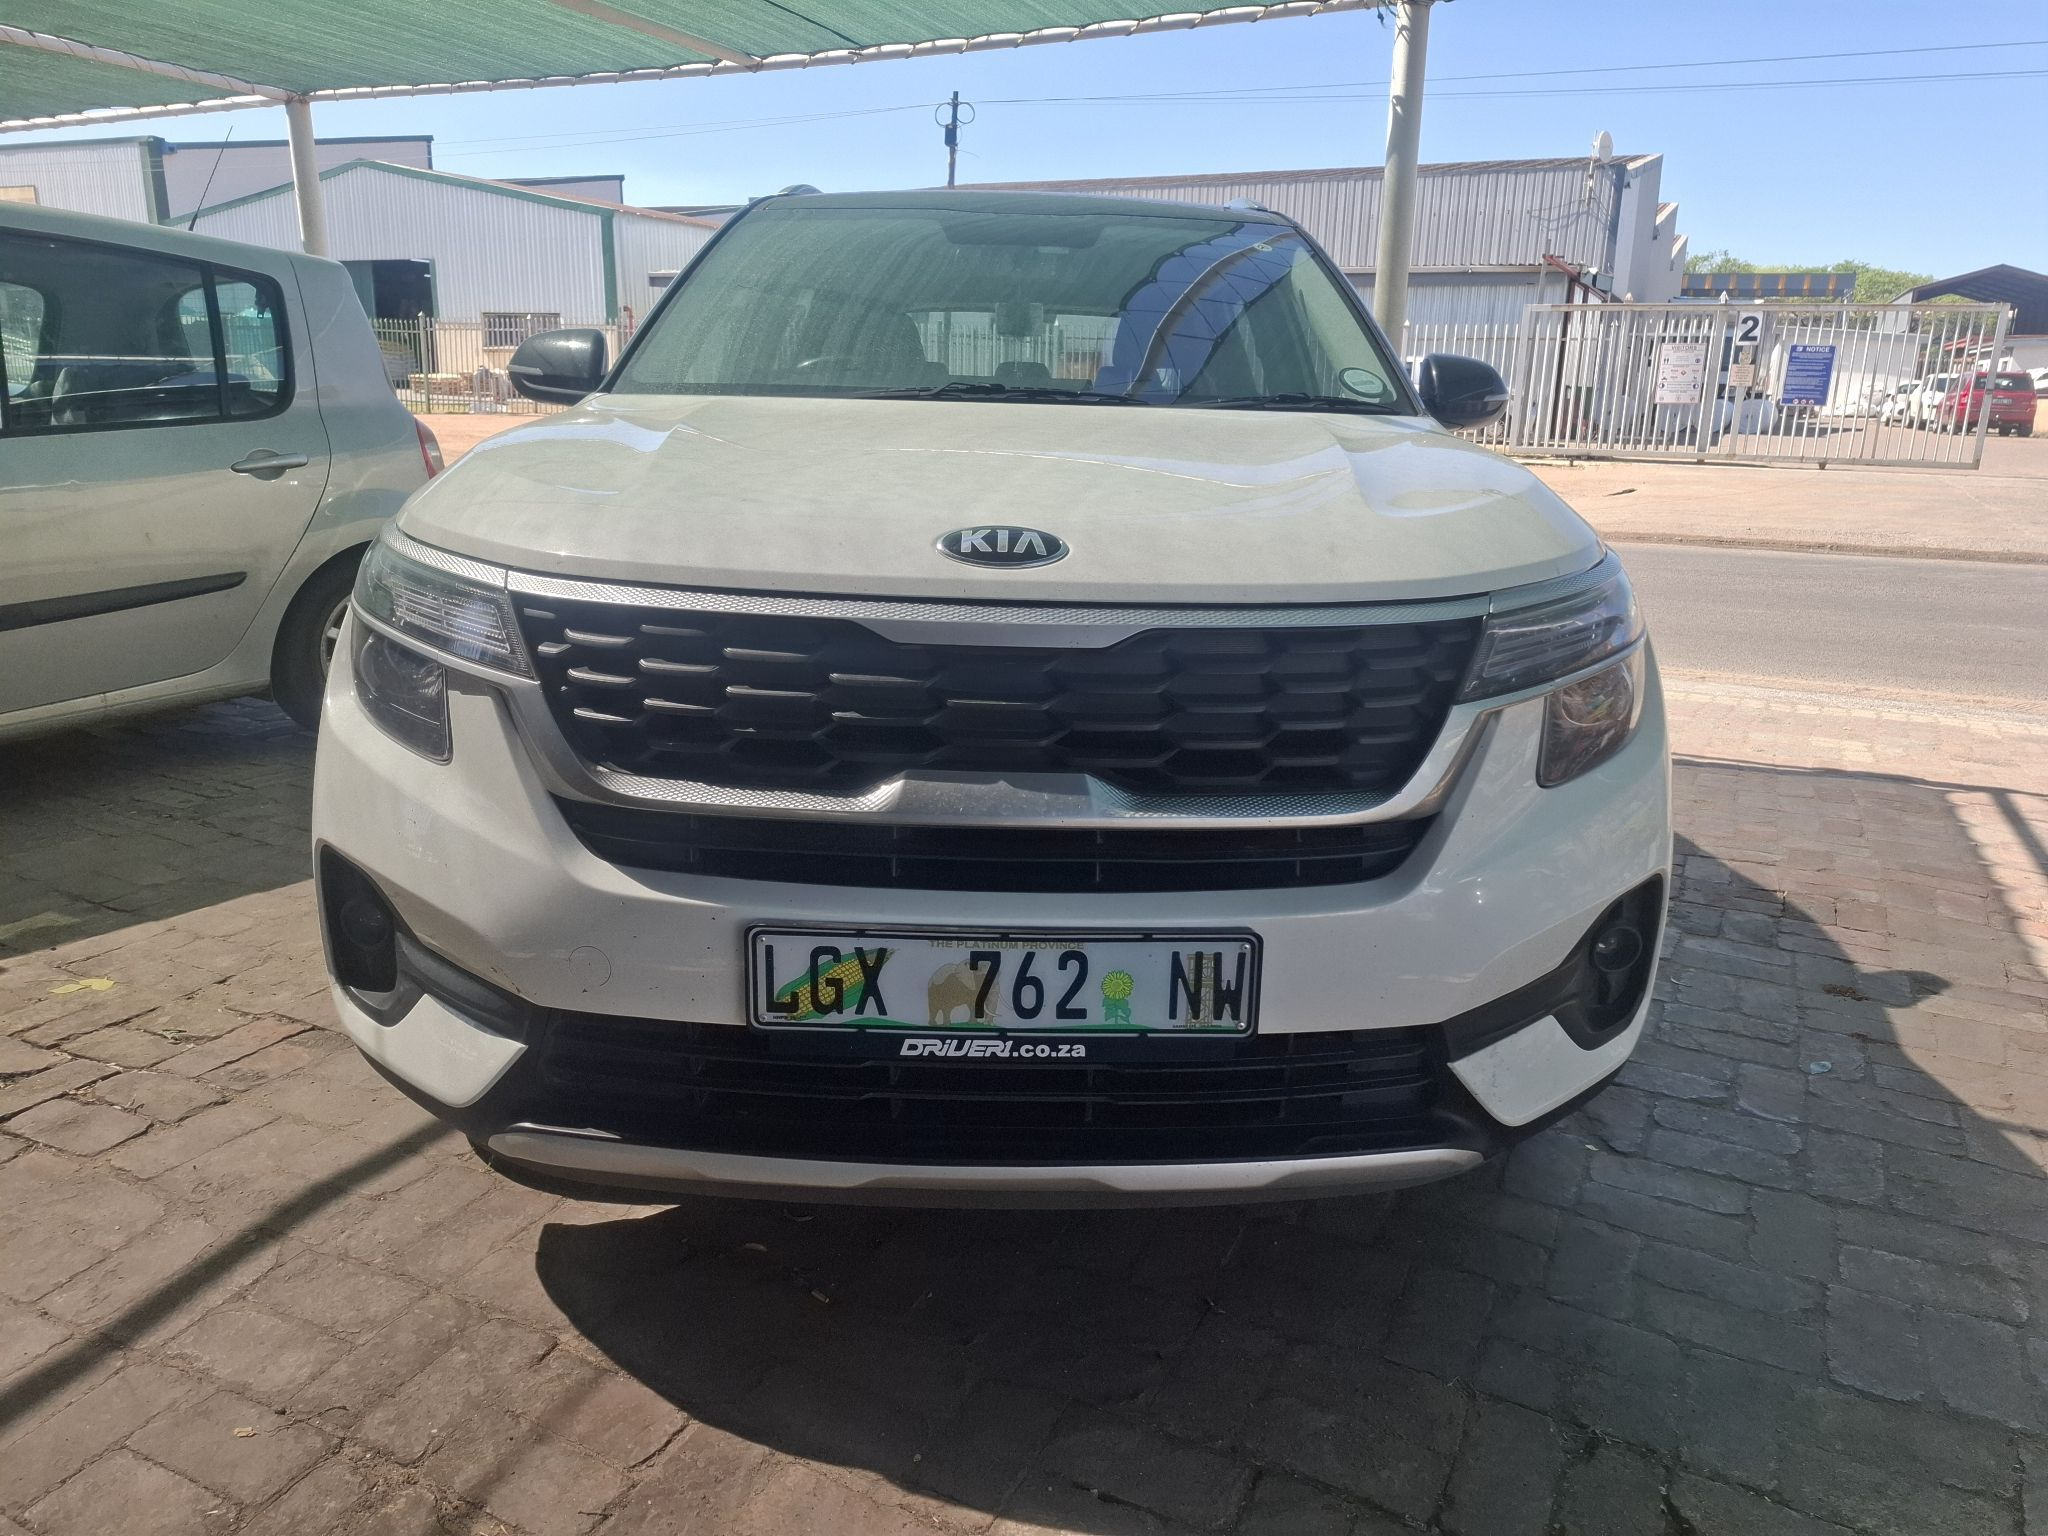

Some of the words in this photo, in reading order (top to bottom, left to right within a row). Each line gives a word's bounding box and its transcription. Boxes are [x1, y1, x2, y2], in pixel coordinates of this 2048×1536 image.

[1738, 315, 1760, 342] 2
[960, 529, 1047, 556] KIA
[930, 940, 953, 949] THE
[1022, 942, 1085, 950] PROVINCE
[764, 944, 888, 1016] LGX
[969, 950, 1089, 1020] 762
[1168, 951, 1247, 1021] NW
